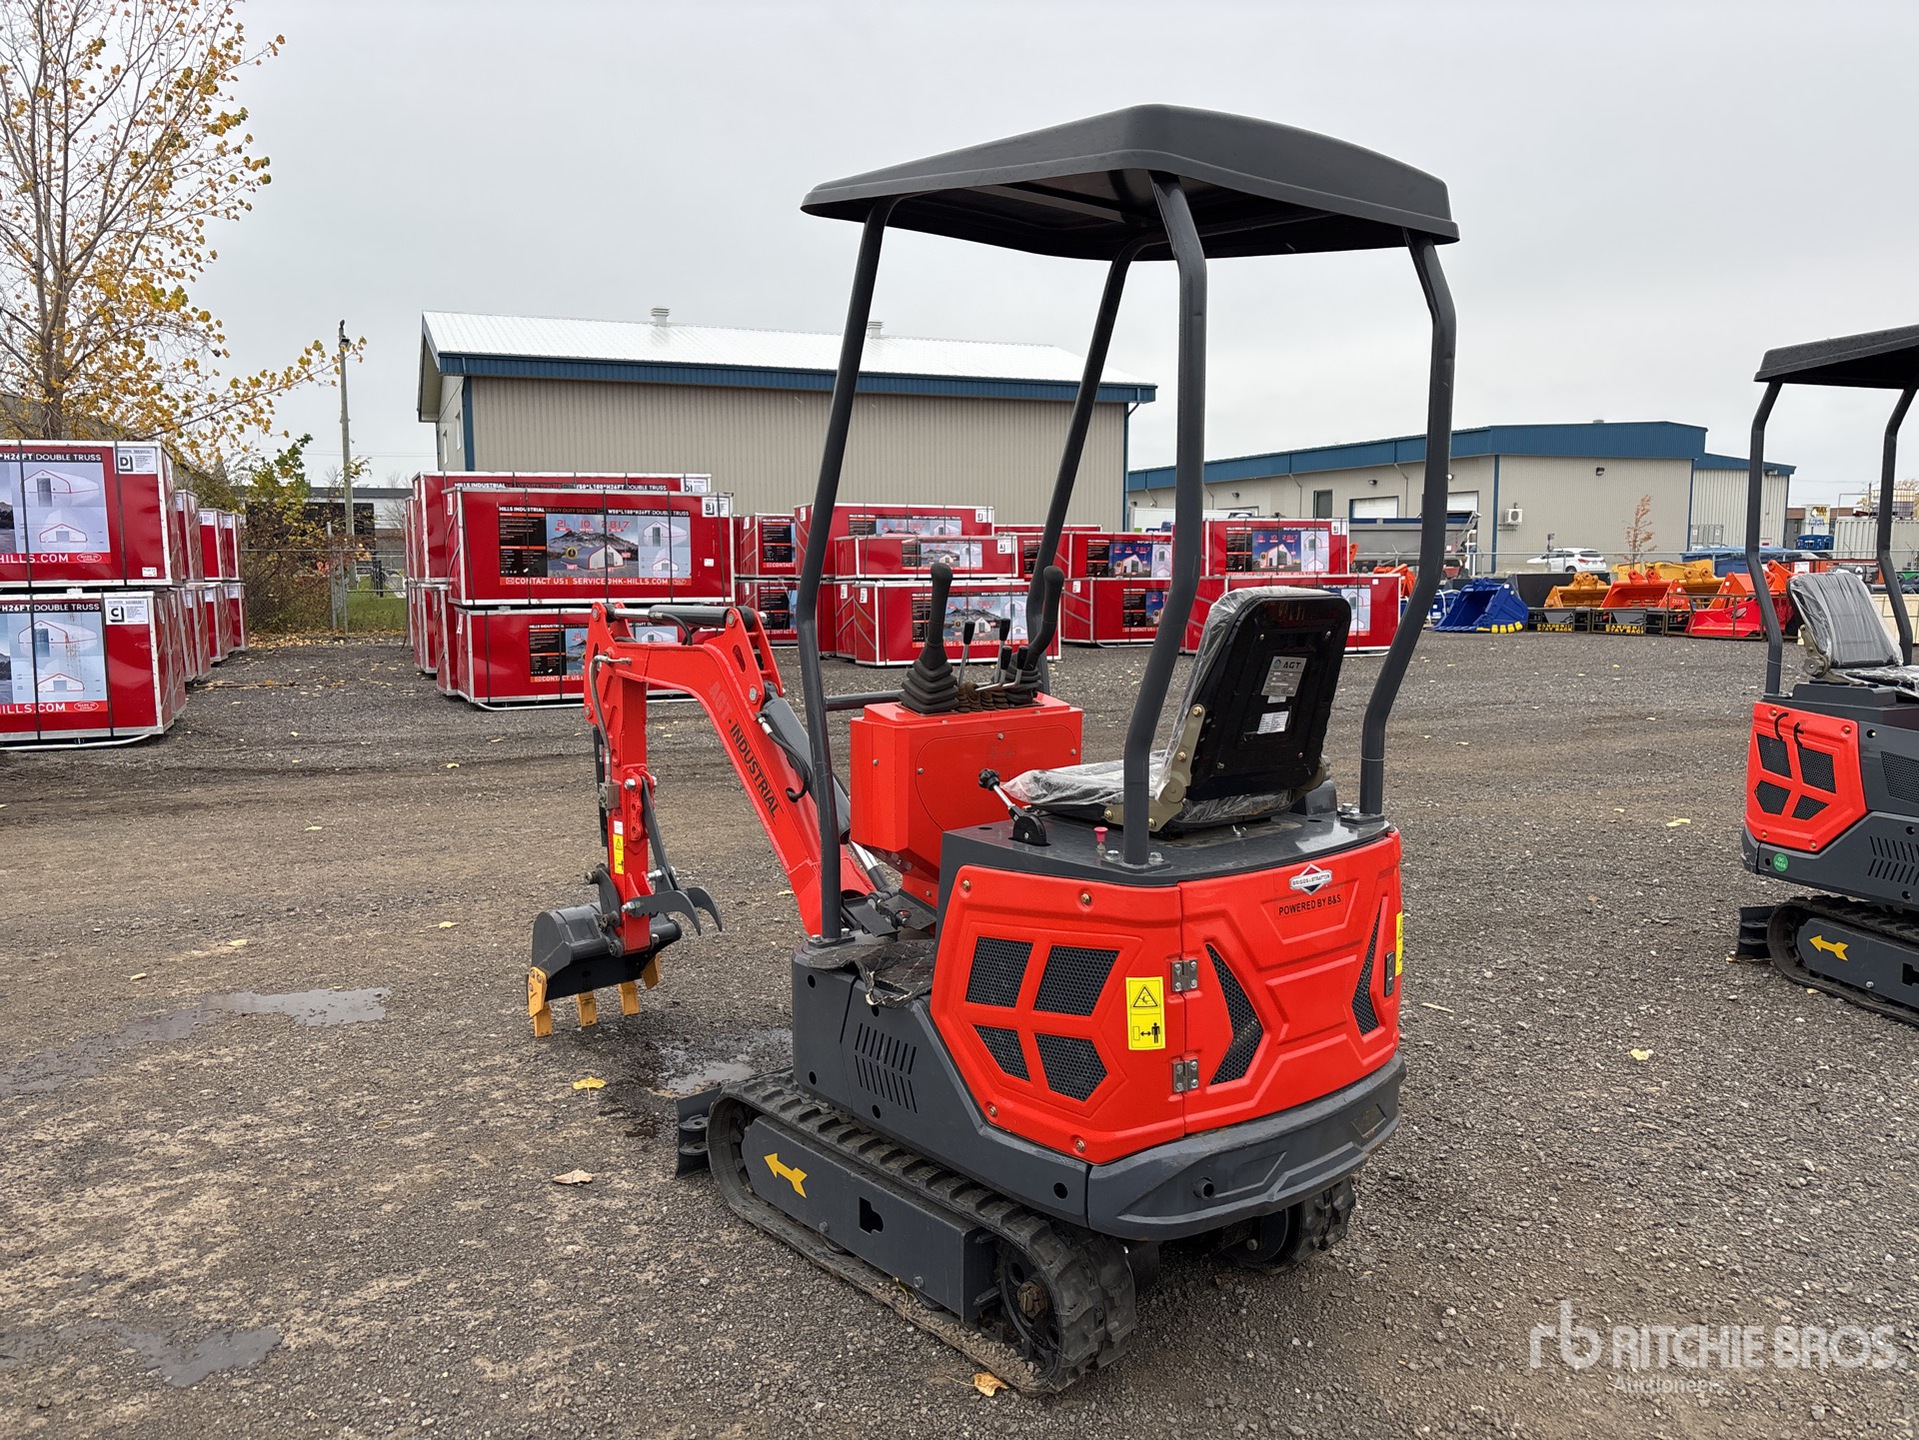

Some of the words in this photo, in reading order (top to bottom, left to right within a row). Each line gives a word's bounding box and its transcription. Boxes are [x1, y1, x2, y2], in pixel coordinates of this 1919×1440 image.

[120, 457, 129, 466] D
[111, 608, 119, 617] C
[708, 681, 733, 722] AGT
[730, 722, 781, 818] INDUSTRIAL
[1278, 900, 1316, 916] POWERED
[1317, 897, 1326, 908] BY
[1327, 894, 1341, 906] B&S
